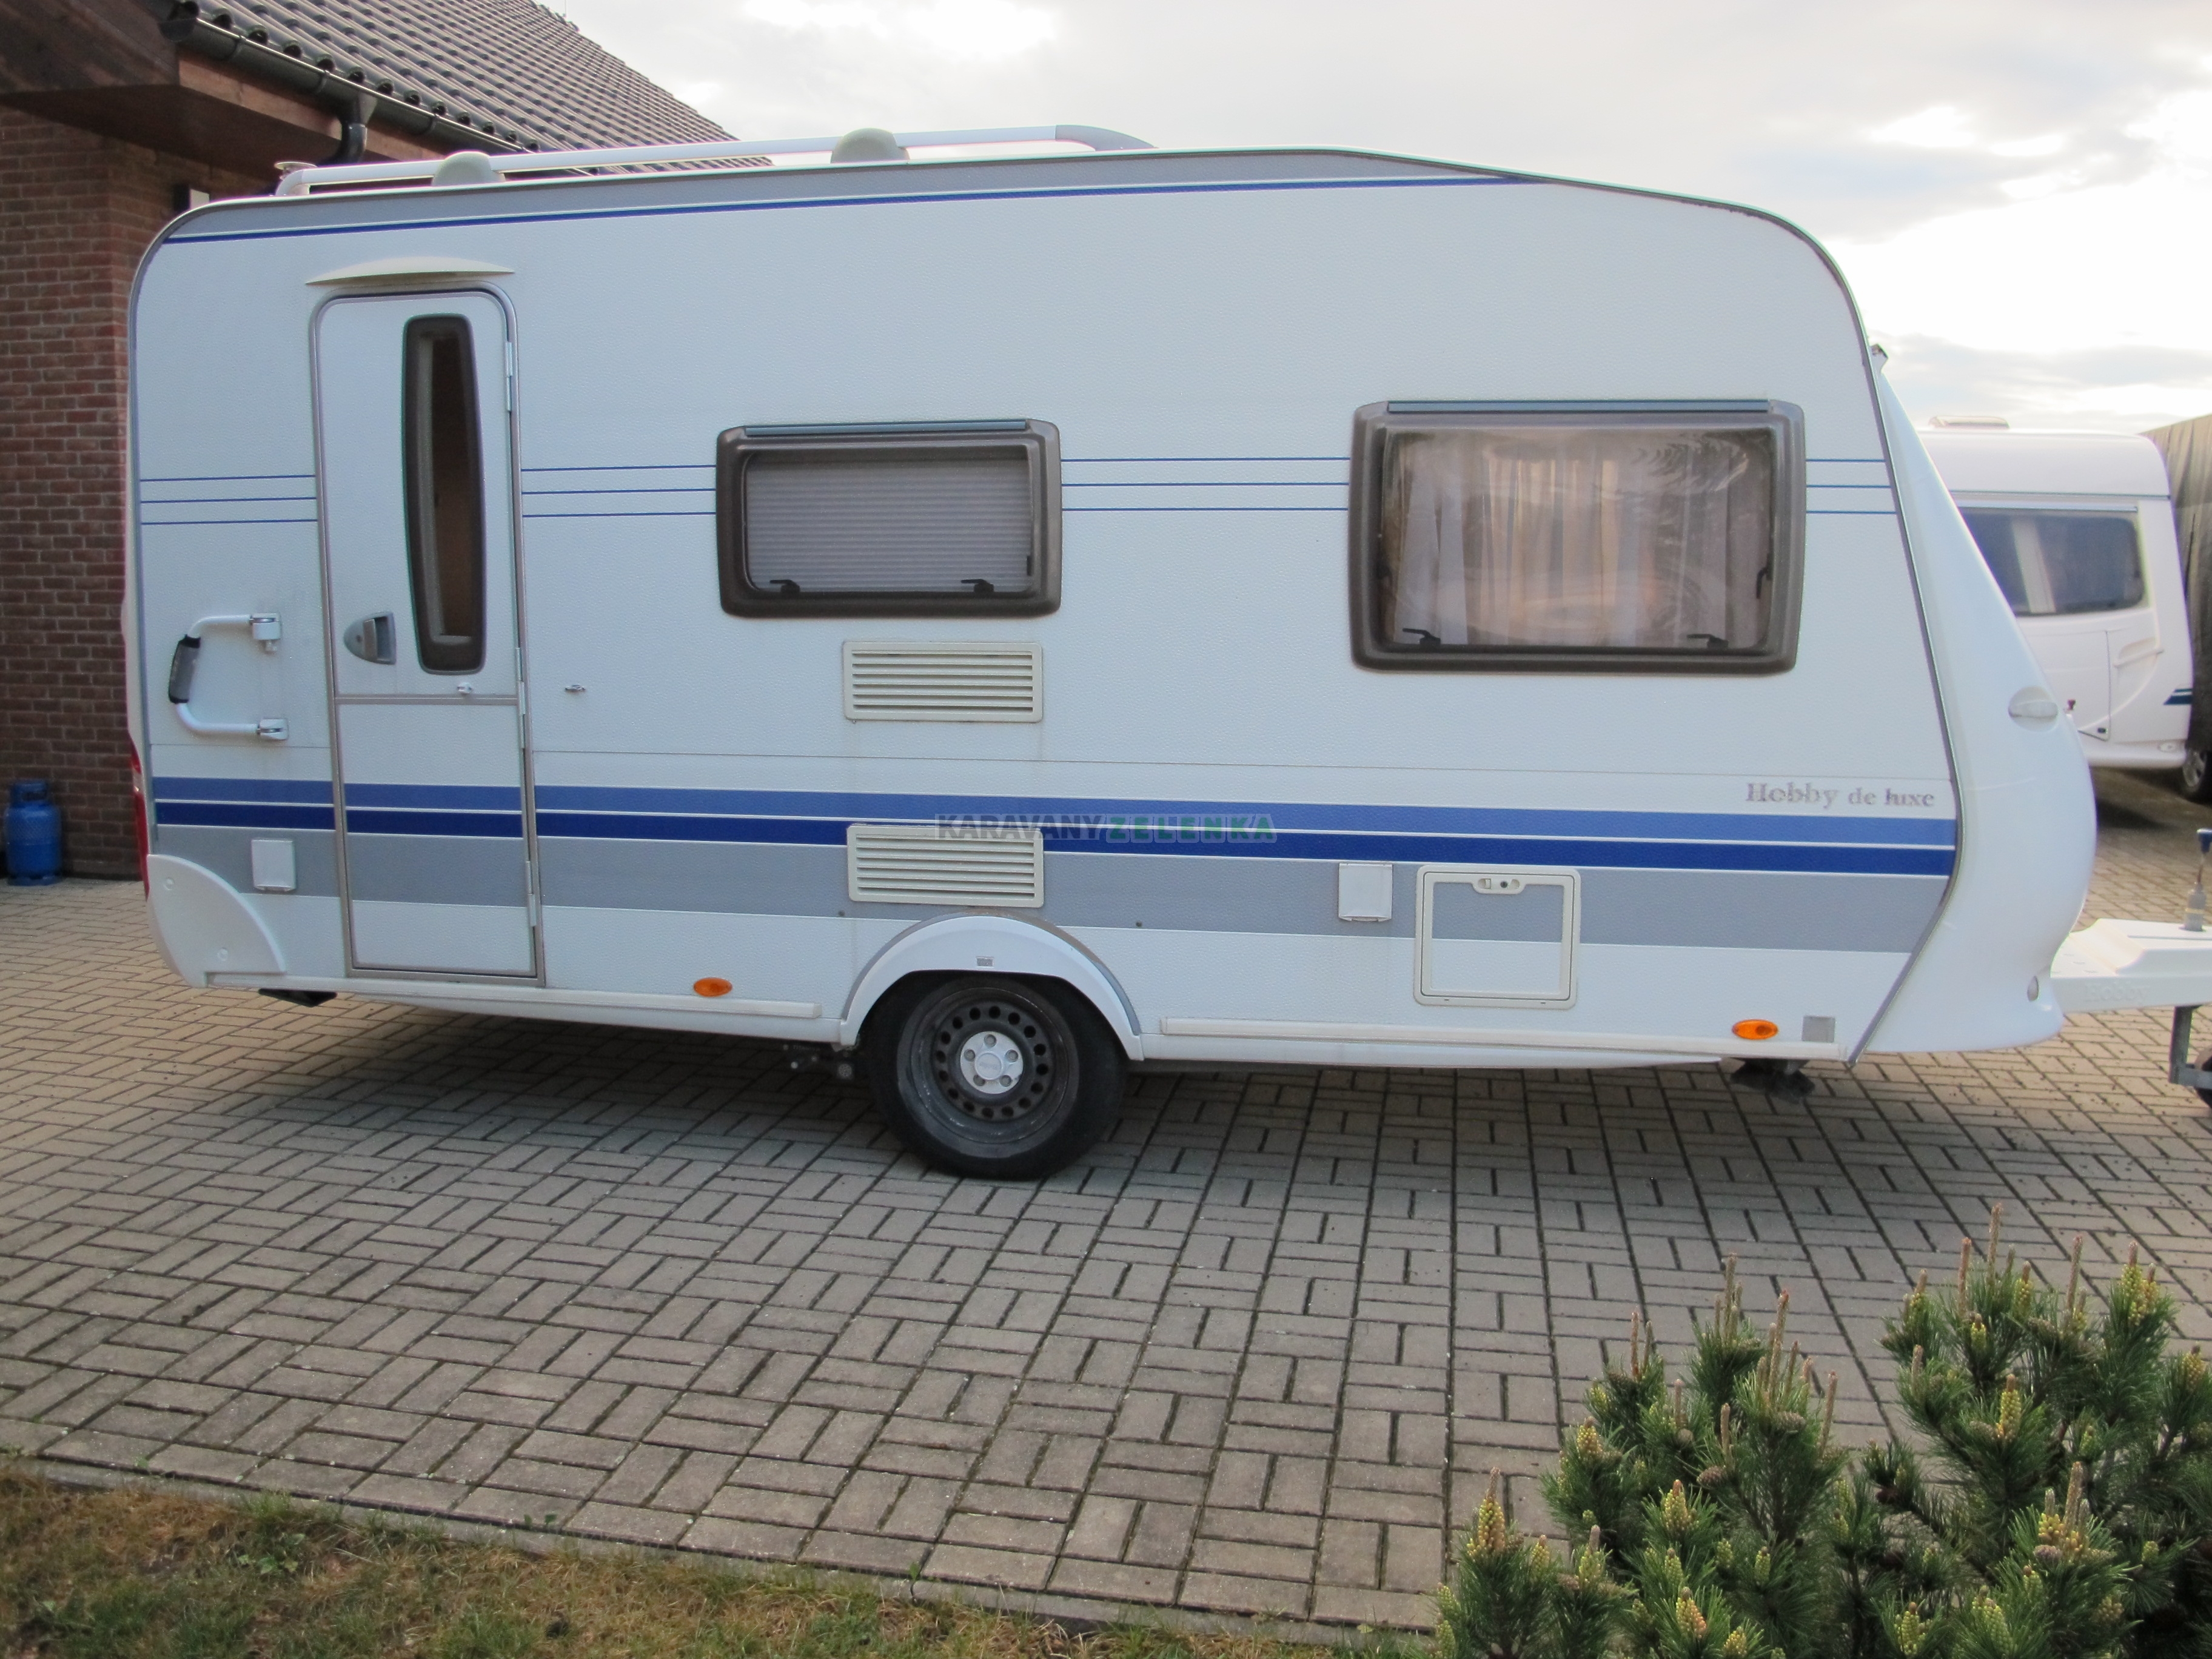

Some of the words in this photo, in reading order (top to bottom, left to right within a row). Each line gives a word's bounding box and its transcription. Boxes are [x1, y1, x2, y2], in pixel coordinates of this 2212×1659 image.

[1745, 782, 1838, 809] Hobby
[1848, 788, 1876, 805] de
[1885, 788, 1934, 807] luxe
